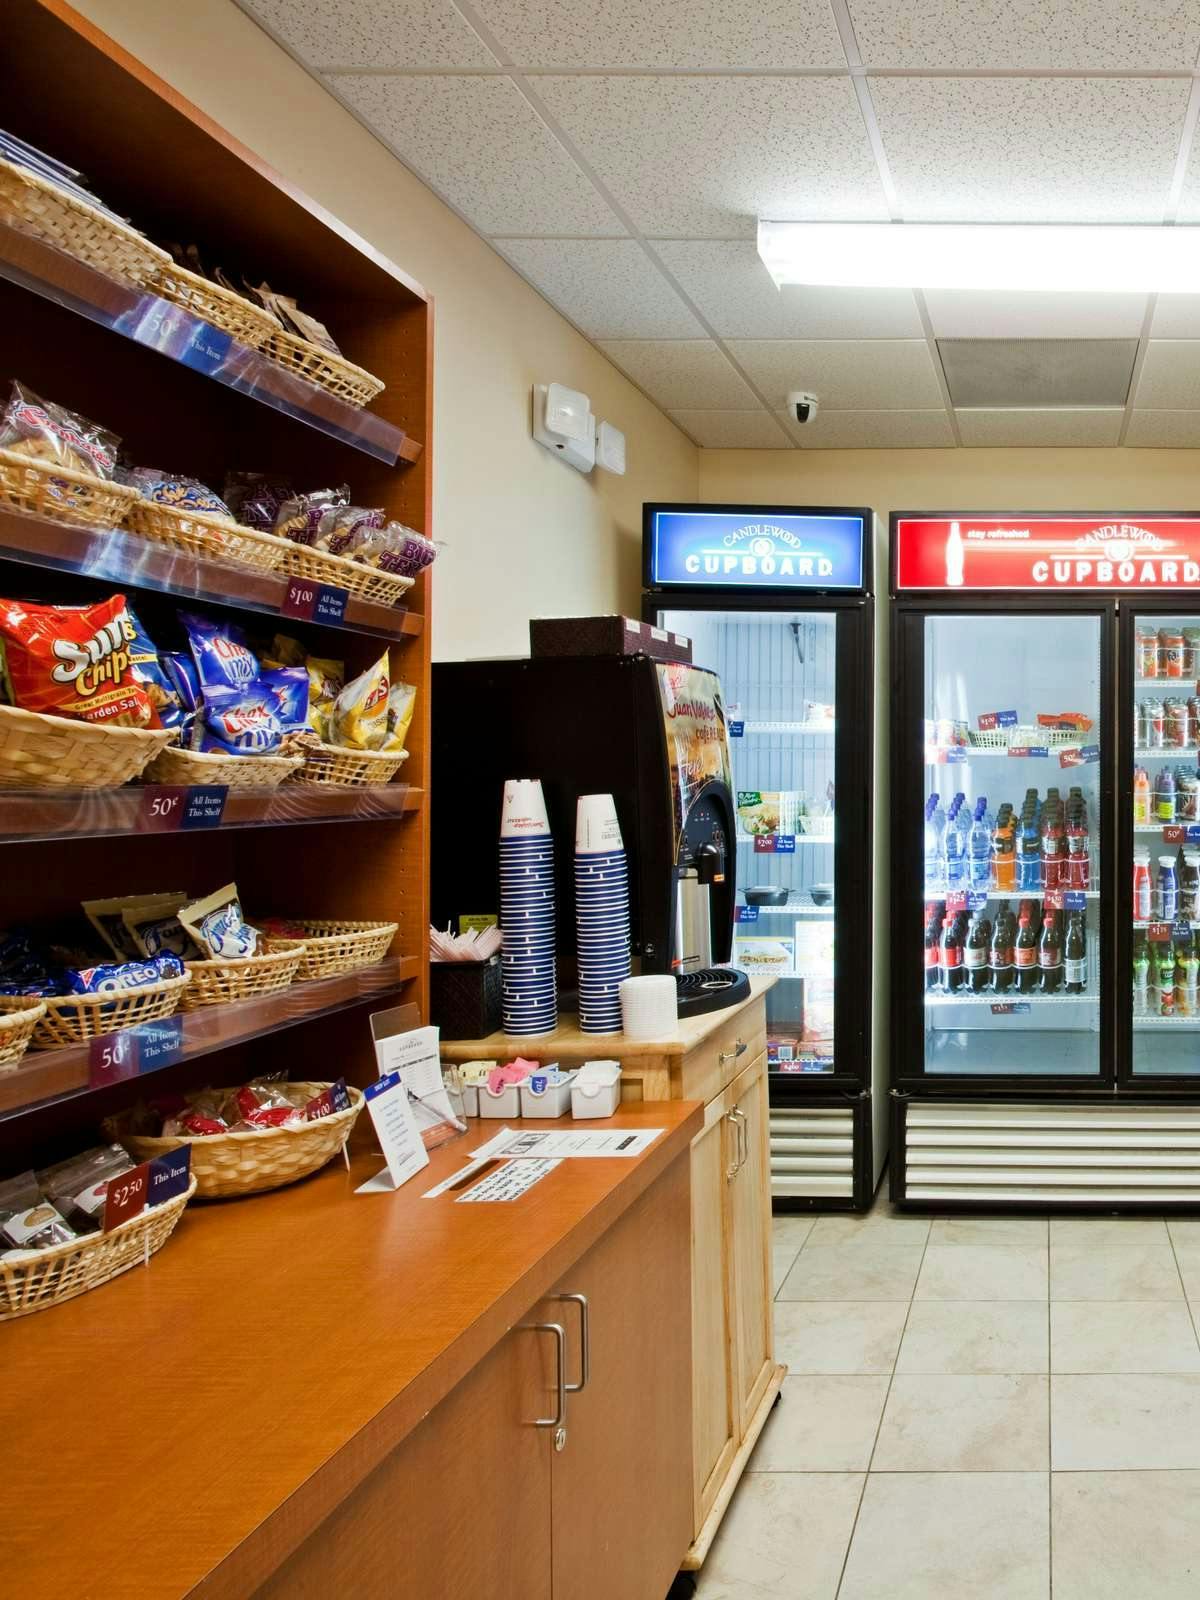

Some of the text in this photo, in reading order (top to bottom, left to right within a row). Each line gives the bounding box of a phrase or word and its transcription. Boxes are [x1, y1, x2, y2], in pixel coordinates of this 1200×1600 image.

[723, 524, 801, 549] CANDLEWOOD
[967, 529, 1030, 540] stay refreshed
[1074, 524, 1163, 551] CANDLEWOOD
[685, 555, 832, 577] CUPBOARD
[1032, 561, 1200, 583] CUPBOARD
[320, 594, 343, 606] All Items
[318, 604, 341, 617] This Shelf
[222, 703, 272, 734] Chex
[192, 796, 221, 805] All Items
[189, 807, 221, 817] This Shelf
[97, 967, 158, 993] OREO
[146, 1032, 158, 1045] All
[144, 1039, 180, 1058] This Shelf
[153, 1166, 186, 1185] This Item
